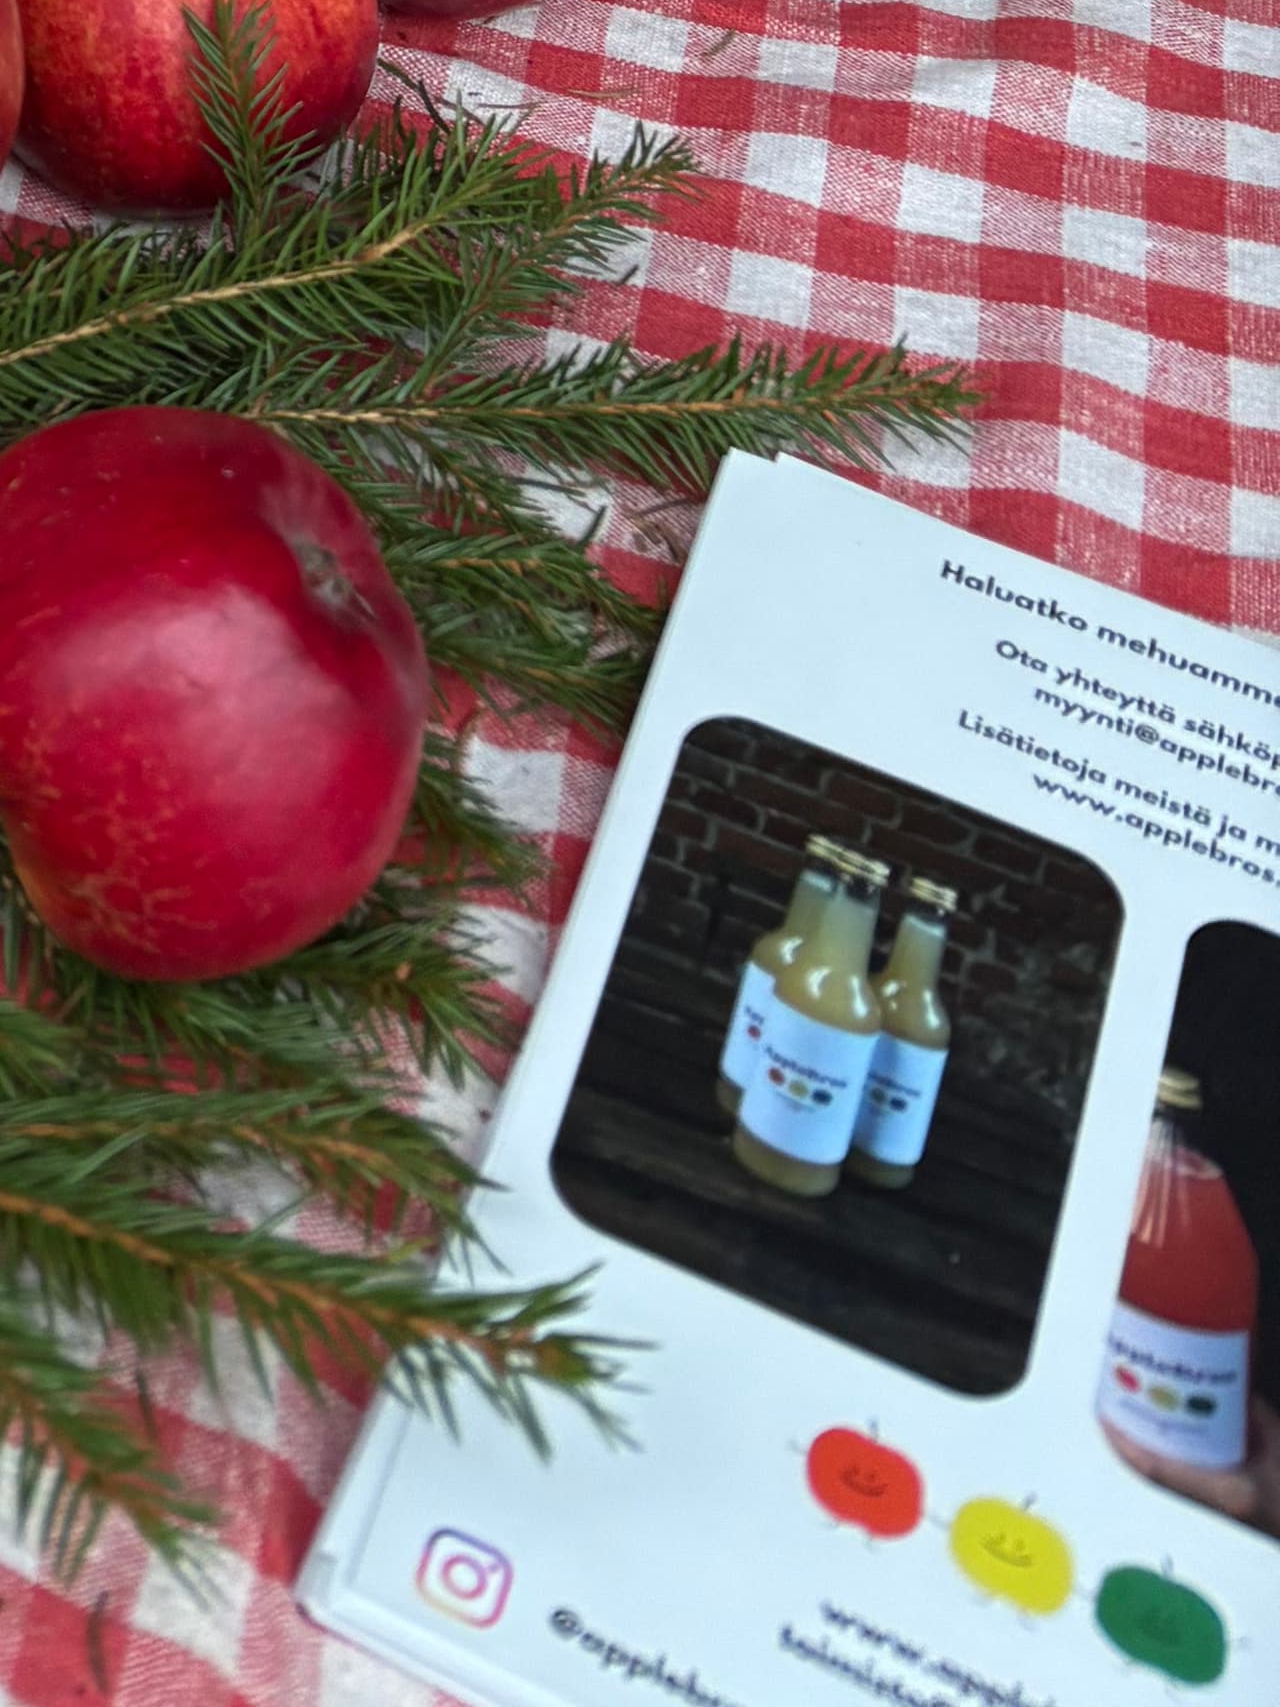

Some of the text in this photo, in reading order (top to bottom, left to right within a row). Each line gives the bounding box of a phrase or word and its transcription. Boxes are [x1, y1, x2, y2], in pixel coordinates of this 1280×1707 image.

[940, 560, 1089, 632] Haluatko
[995, 640, 1049, 674] Ota
[1055, 666, 1177, 725] yhteyttä
[958, 709, 1108, 783] Lisätietoja
[1114, 773, 1212, 827] meistä
[1215, 814, 1248, 841] ja
